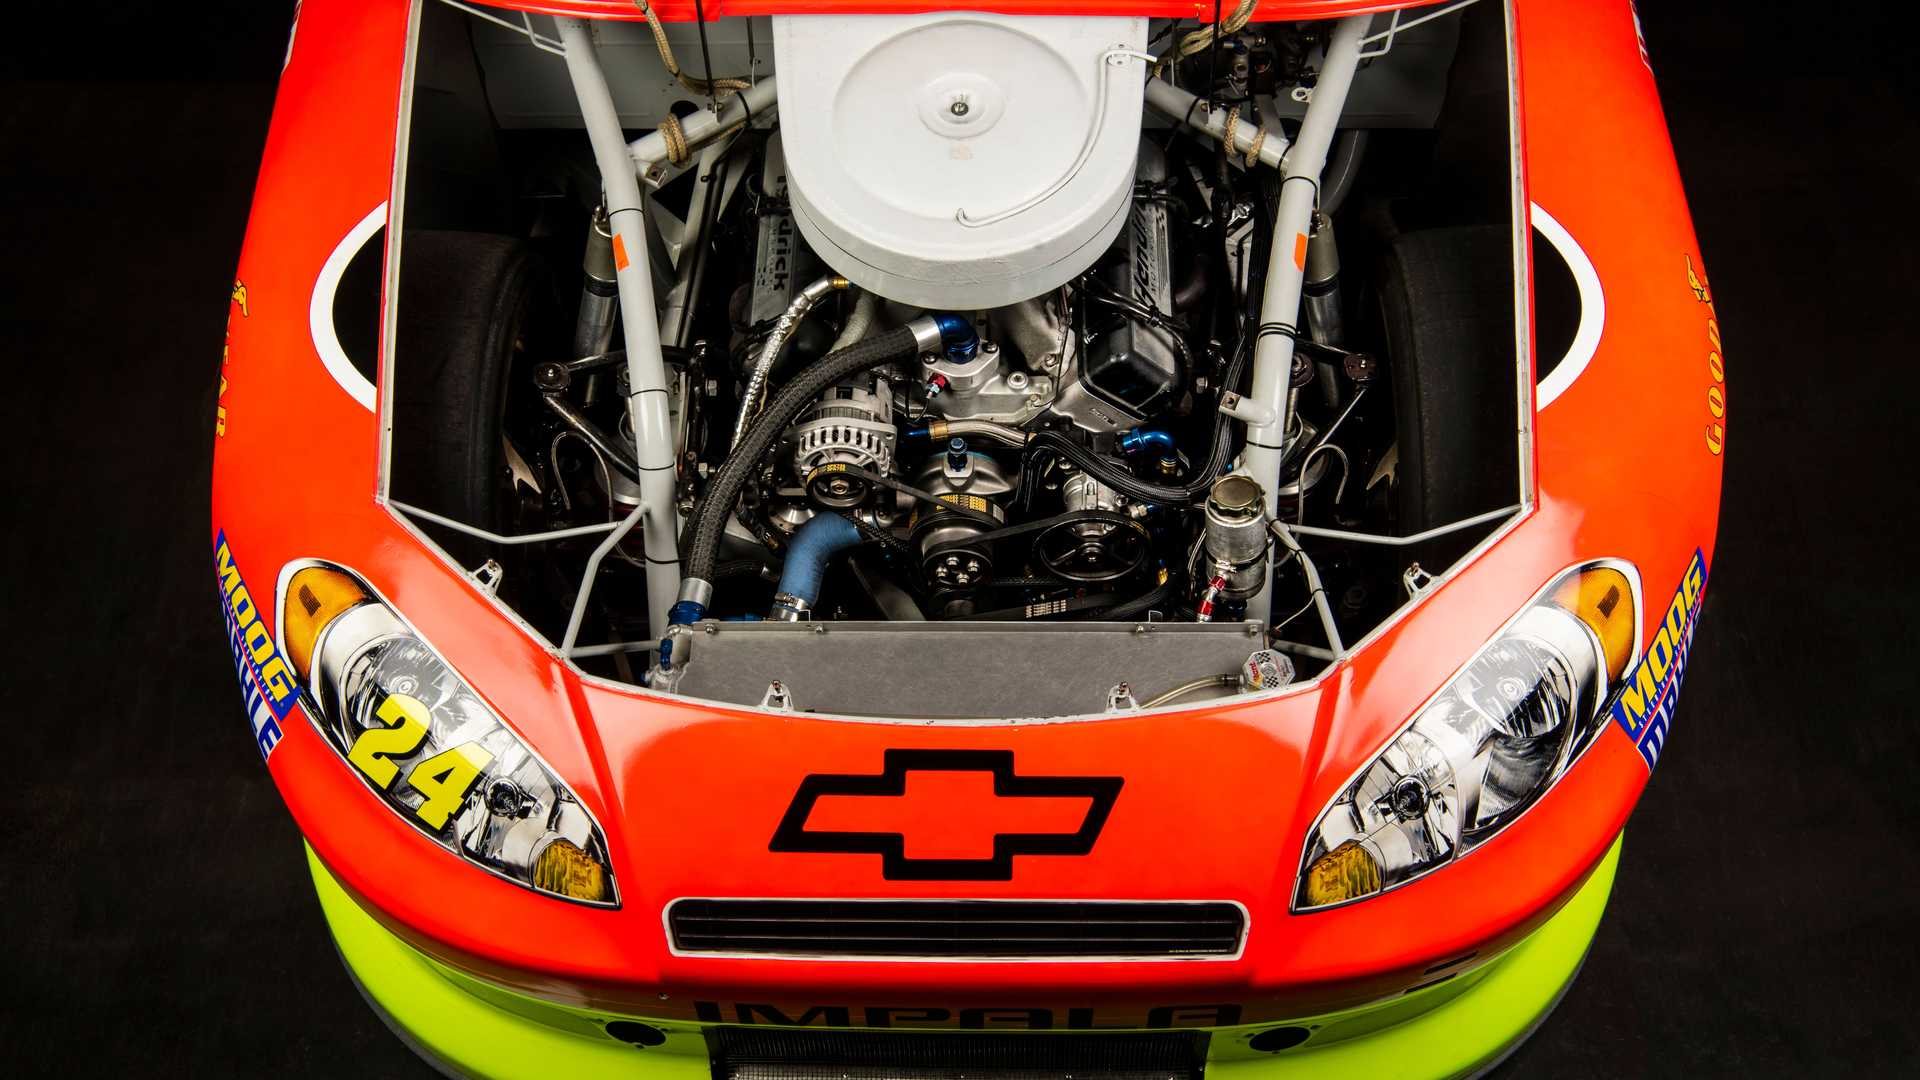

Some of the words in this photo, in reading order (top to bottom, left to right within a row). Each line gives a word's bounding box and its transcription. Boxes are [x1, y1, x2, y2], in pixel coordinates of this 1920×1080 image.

[774, 176, 792, 291] drick
[216, 541, 297, 703] MOOG
[1620, 554, 1702, 731] MOOG
[347, 693, 496, 832] 24
[694, 1001, 1242, 1031] IMPALA
